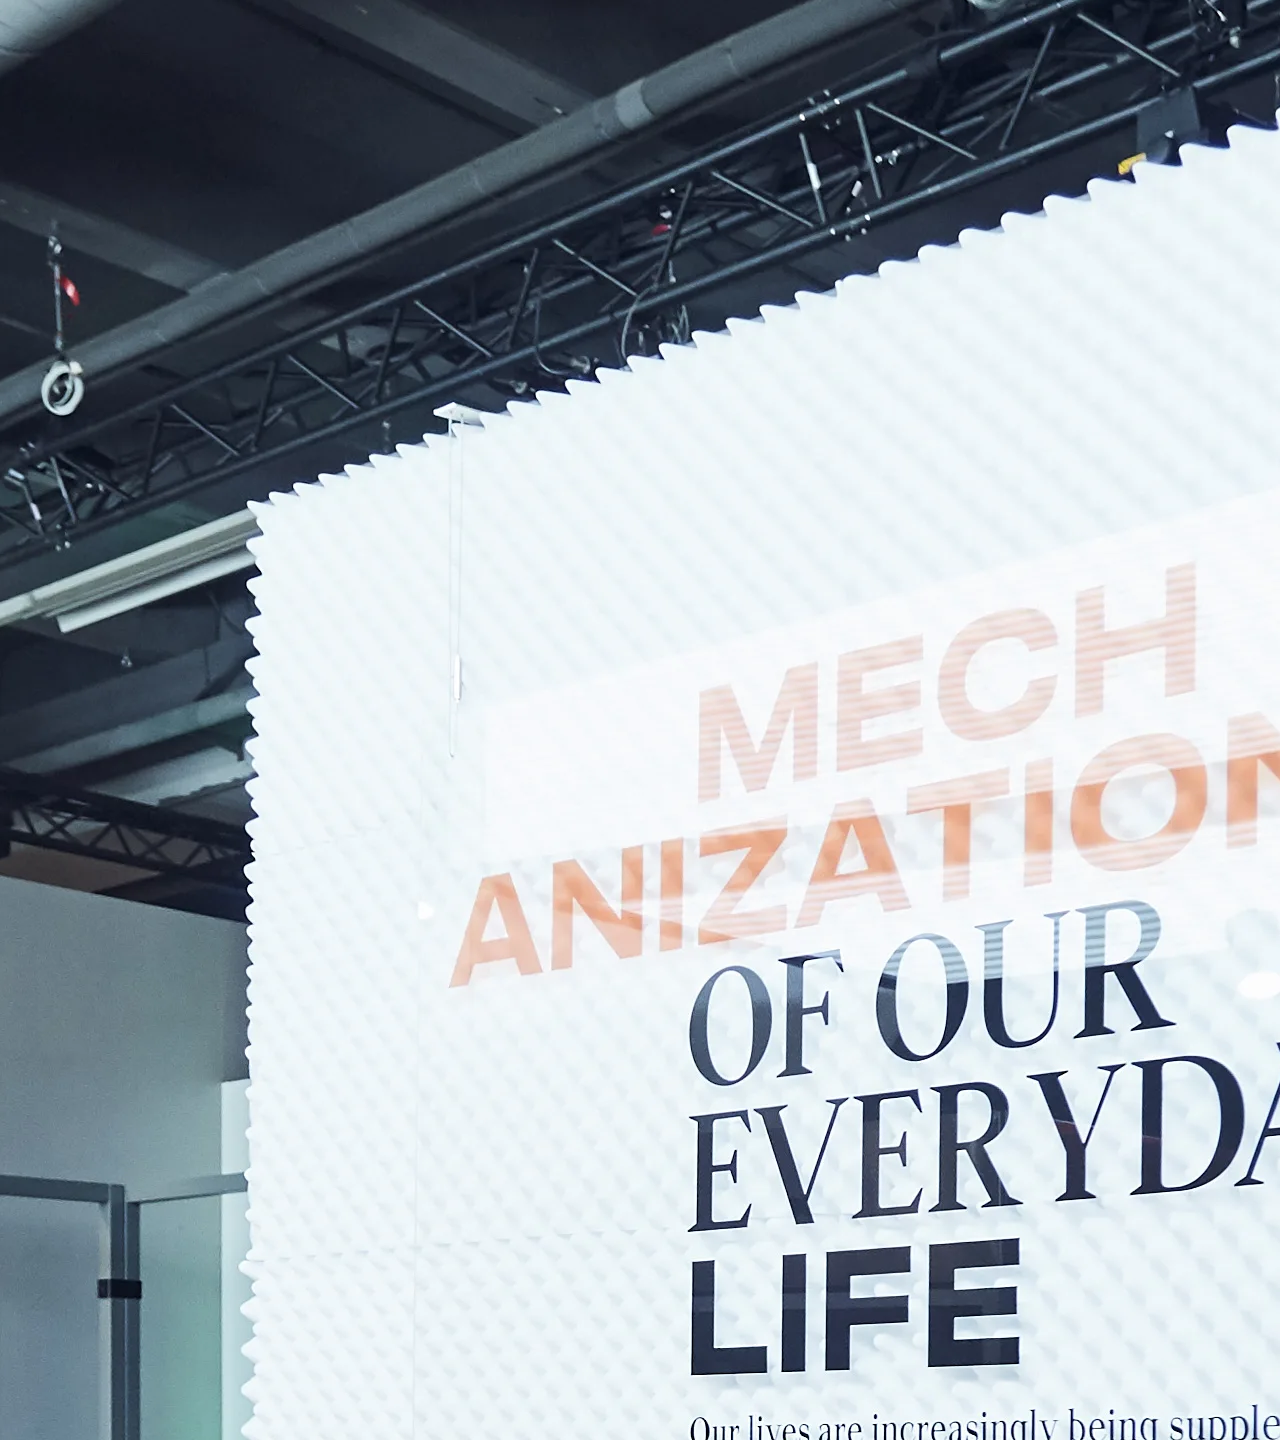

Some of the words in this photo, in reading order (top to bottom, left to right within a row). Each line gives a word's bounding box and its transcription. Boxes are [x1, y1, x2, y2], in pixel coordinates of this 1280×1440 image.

[695, 561, 1198, 805] MECH
[688, 948, 845, 1087] OF
[875, 899, 1177, 1062] OUR
[690, 1236, 1022, 1377] LIFE
